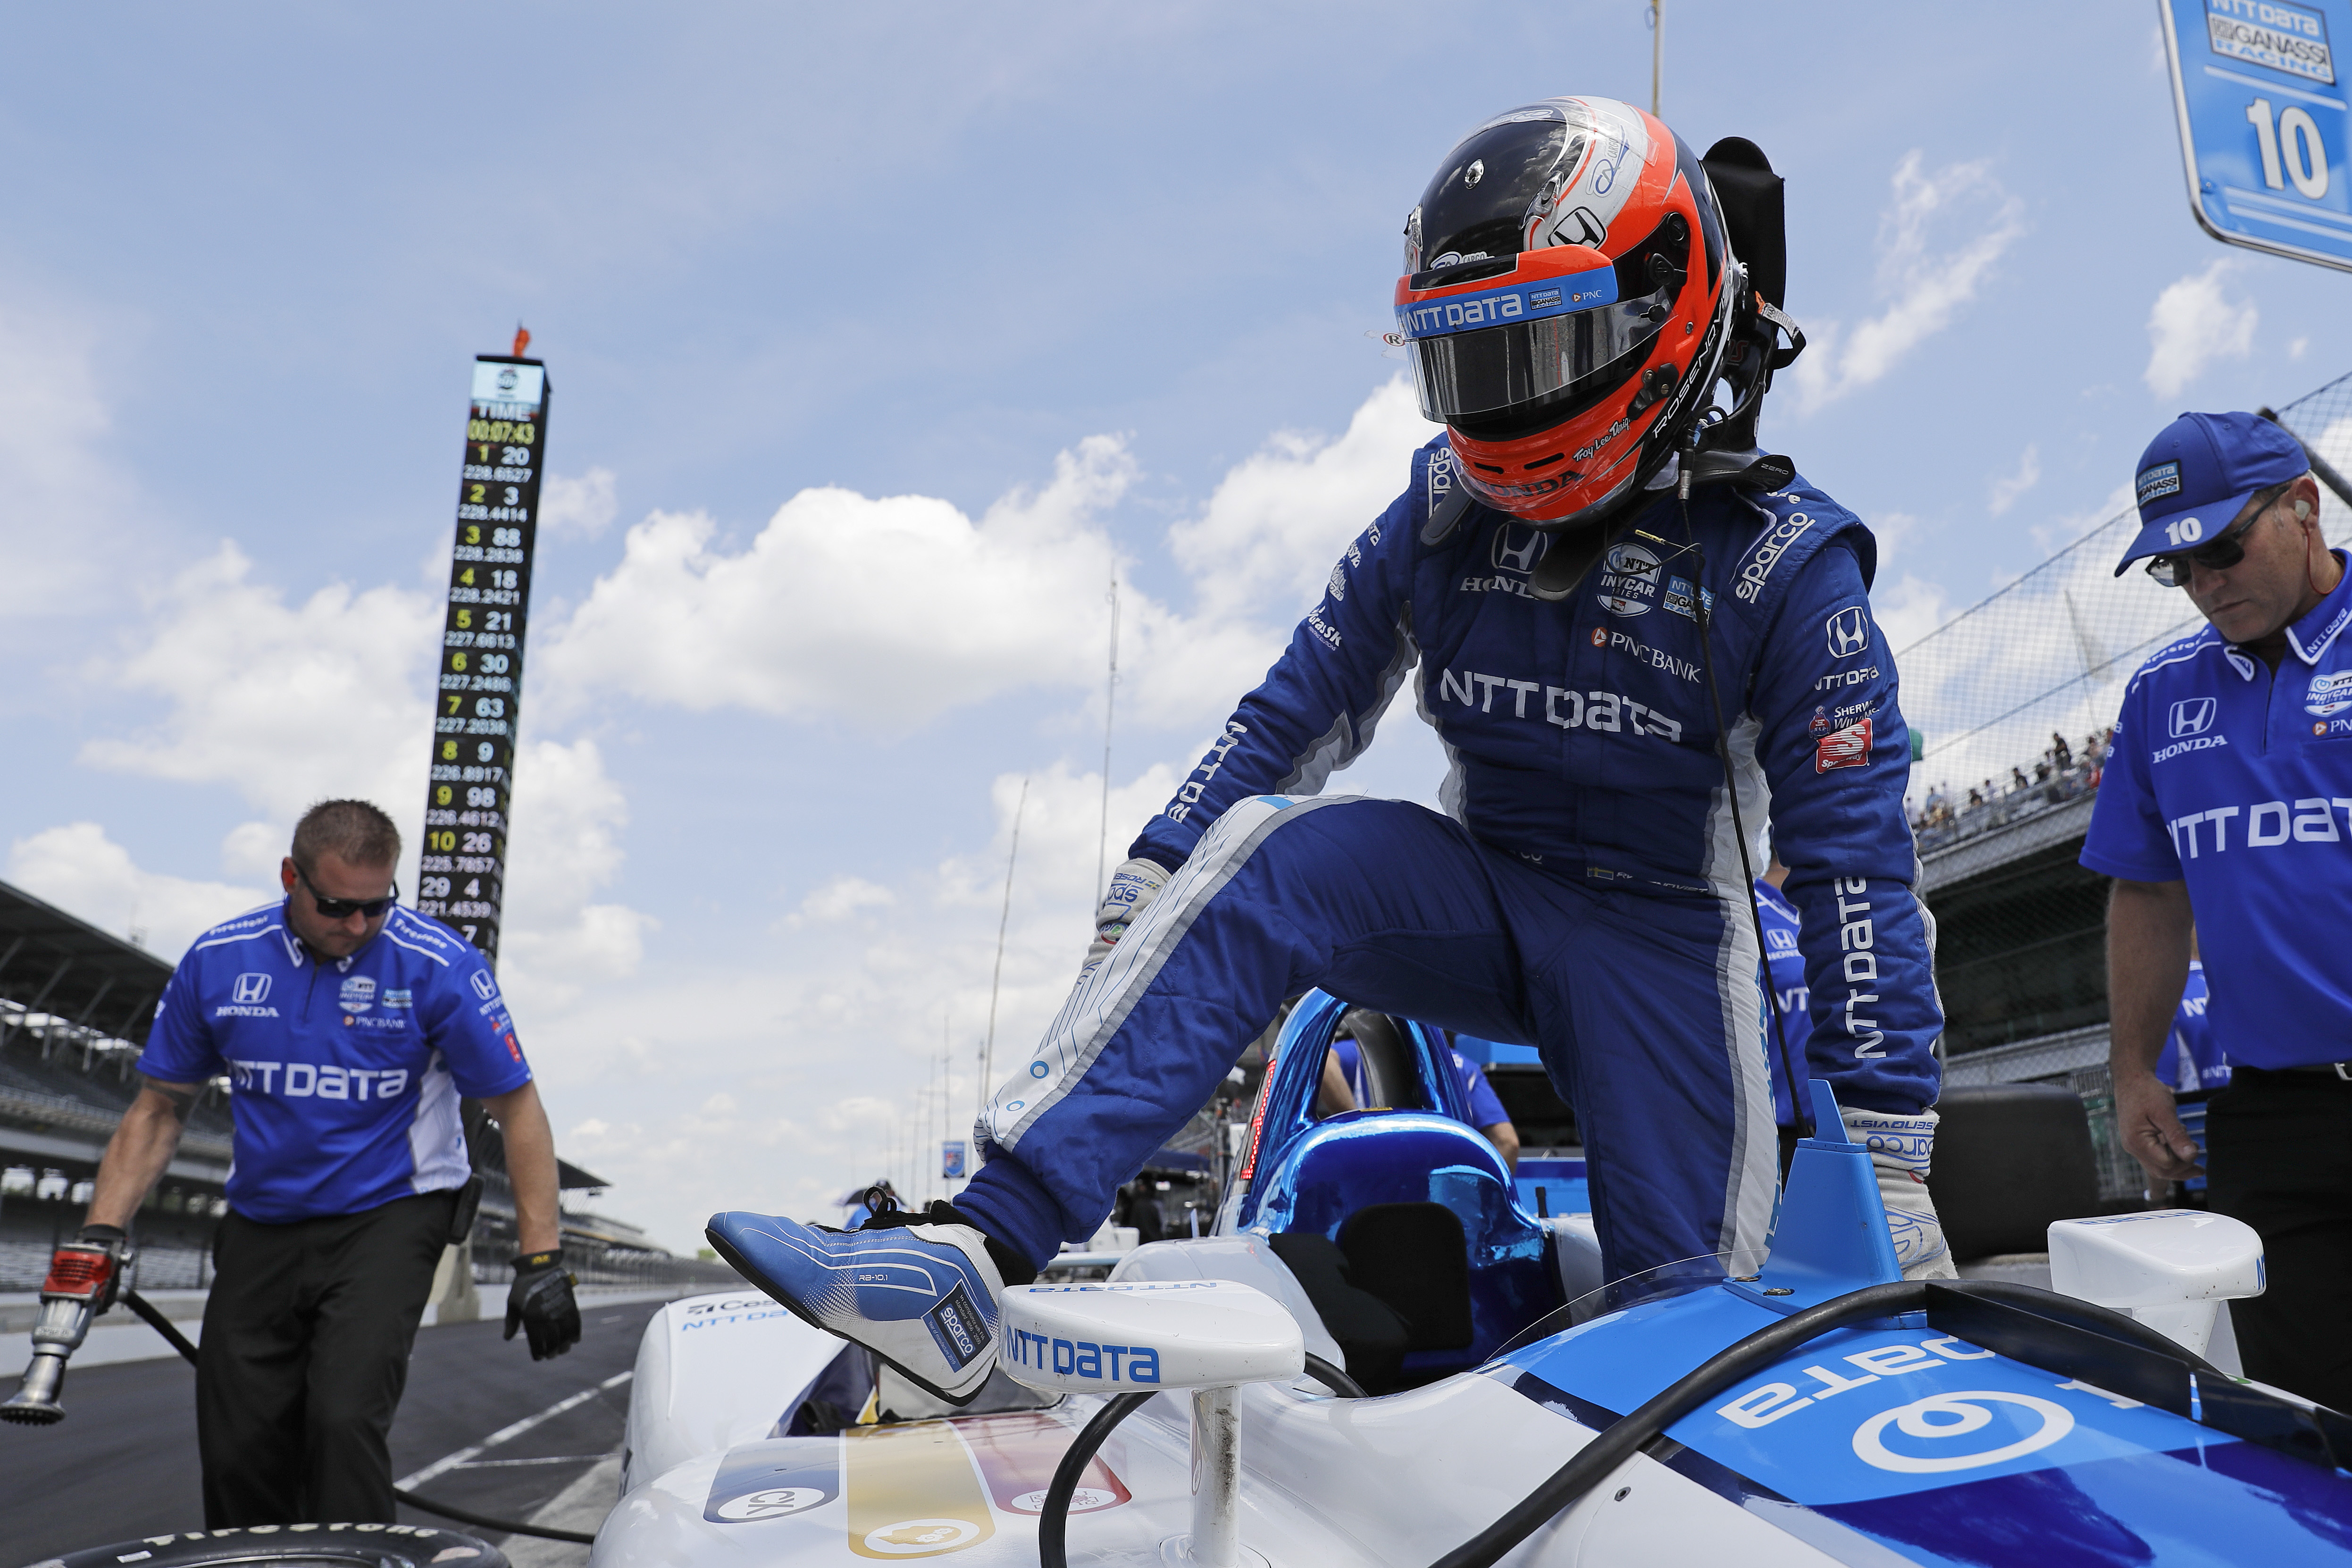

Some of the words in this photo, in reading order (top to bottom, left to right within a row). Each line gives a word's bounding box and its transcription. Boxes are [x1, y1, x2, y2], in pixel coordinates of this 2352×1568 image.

[2235, 25, 2327, 65] GANASSI
[2246, 97, 2329, 200] 10
[1537, 296, 1560, 305] GANASSI
[1582, 289, 1602, 300] PNC
[1406, 306, 1442, 331] NTT
[1389, 334, 1401, 345] R
[478, 401, 532, 421] TIME
[1573, 447, 1593, 462] Troy
[1595, 435, 1611, 452] Lee
[1609, 417, 1631, 439] Desig
[478, 444, 489, 462] 1
[500, 446, 530, 466] 20
[1761, 463, 1789, 475] ZERO
[469, 484, 486, 503] 2
[503, 486, 519, 506] 3
[459, 503, 528, 523] 228.4414
[465, 525, 481, 545] 3
[492, 527, 521, 547] 88
[2165, 517, 2202, 546] 10
[1736, 511, 1816, 604] sparco
[459, 567, 476, 587] 4
[490, 569, 518, 589] 18
[456, 609, 472, 629] 5
[484, 611, 512, 632] 21
[2307, 630, 2327, 654] NTT
[452, 652, 468, 672] 6
[479, 653, 509, 674] 30
[1611, 631, 1649, 663] PNC
[1651, 648, 1701, 683] BANK
[1440, 668, 1540, 718] NTT
[446, 695, 462, 715] 7
[475, 697, 504, 718] 63
[442, 740, 458, 760] 8
[477, 741, 494, 763] 9
[2151, 734, 2228, 765] HONDA
[436, 785, 453, 806] 9
[466, 786, 496, 808] 98
[428, 830, 456, 852] 10
[461, 831, 492, 854] 26
[419, 876, 451, 898] 29
[463, 878, 481, 899] 4
[215, 1006, 280, 1018] HONDA
[377, 1017, 407, 1030] BANK
[941, 1307, 974, 1356] sparco
[1006, 1323, 1048, 1370] NTT
[947, 1352, 957, 1365] 2019
